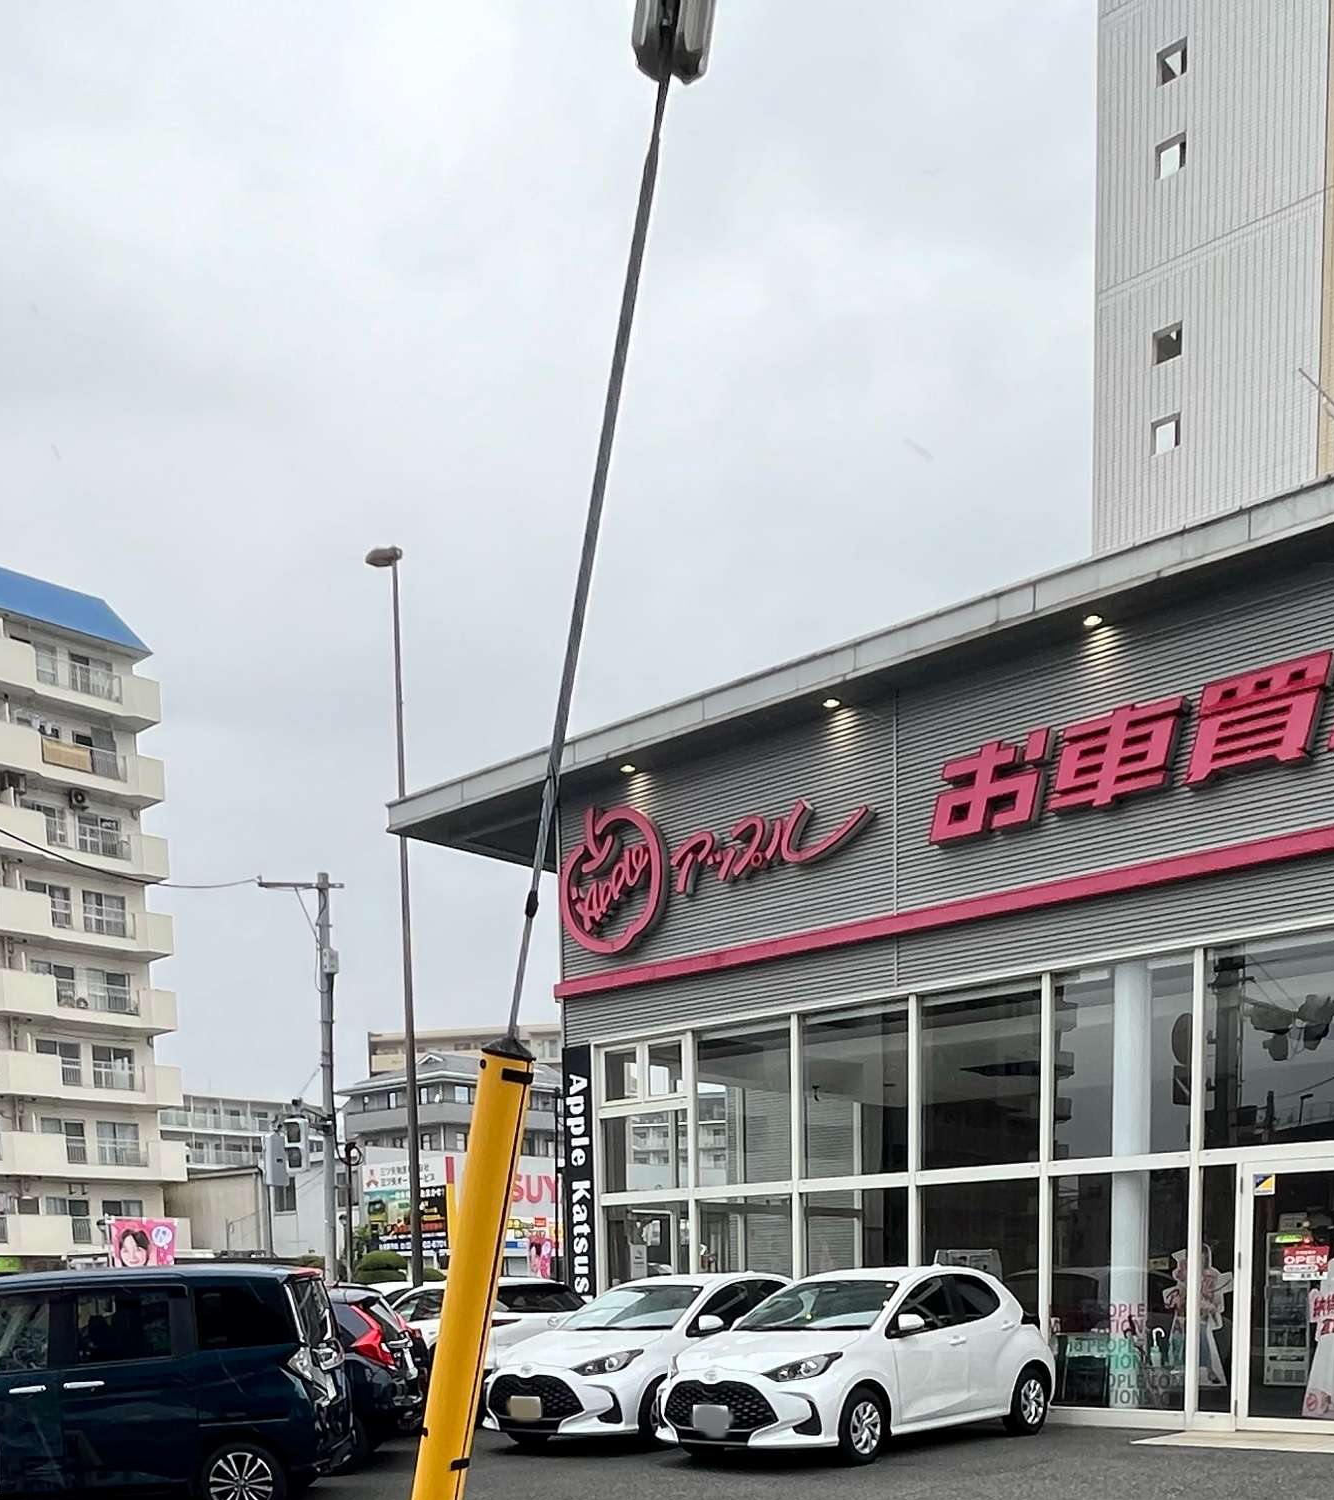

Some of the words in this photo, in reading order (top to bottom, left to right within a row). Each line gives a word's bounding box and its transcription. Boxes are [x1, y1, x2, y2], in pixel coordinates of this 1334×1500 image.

[566, 1073, 590, 1167] Apple
[571, 1180, 595, 1304] Katsus
[1283, 1254, 1328, 1265] OPEN
